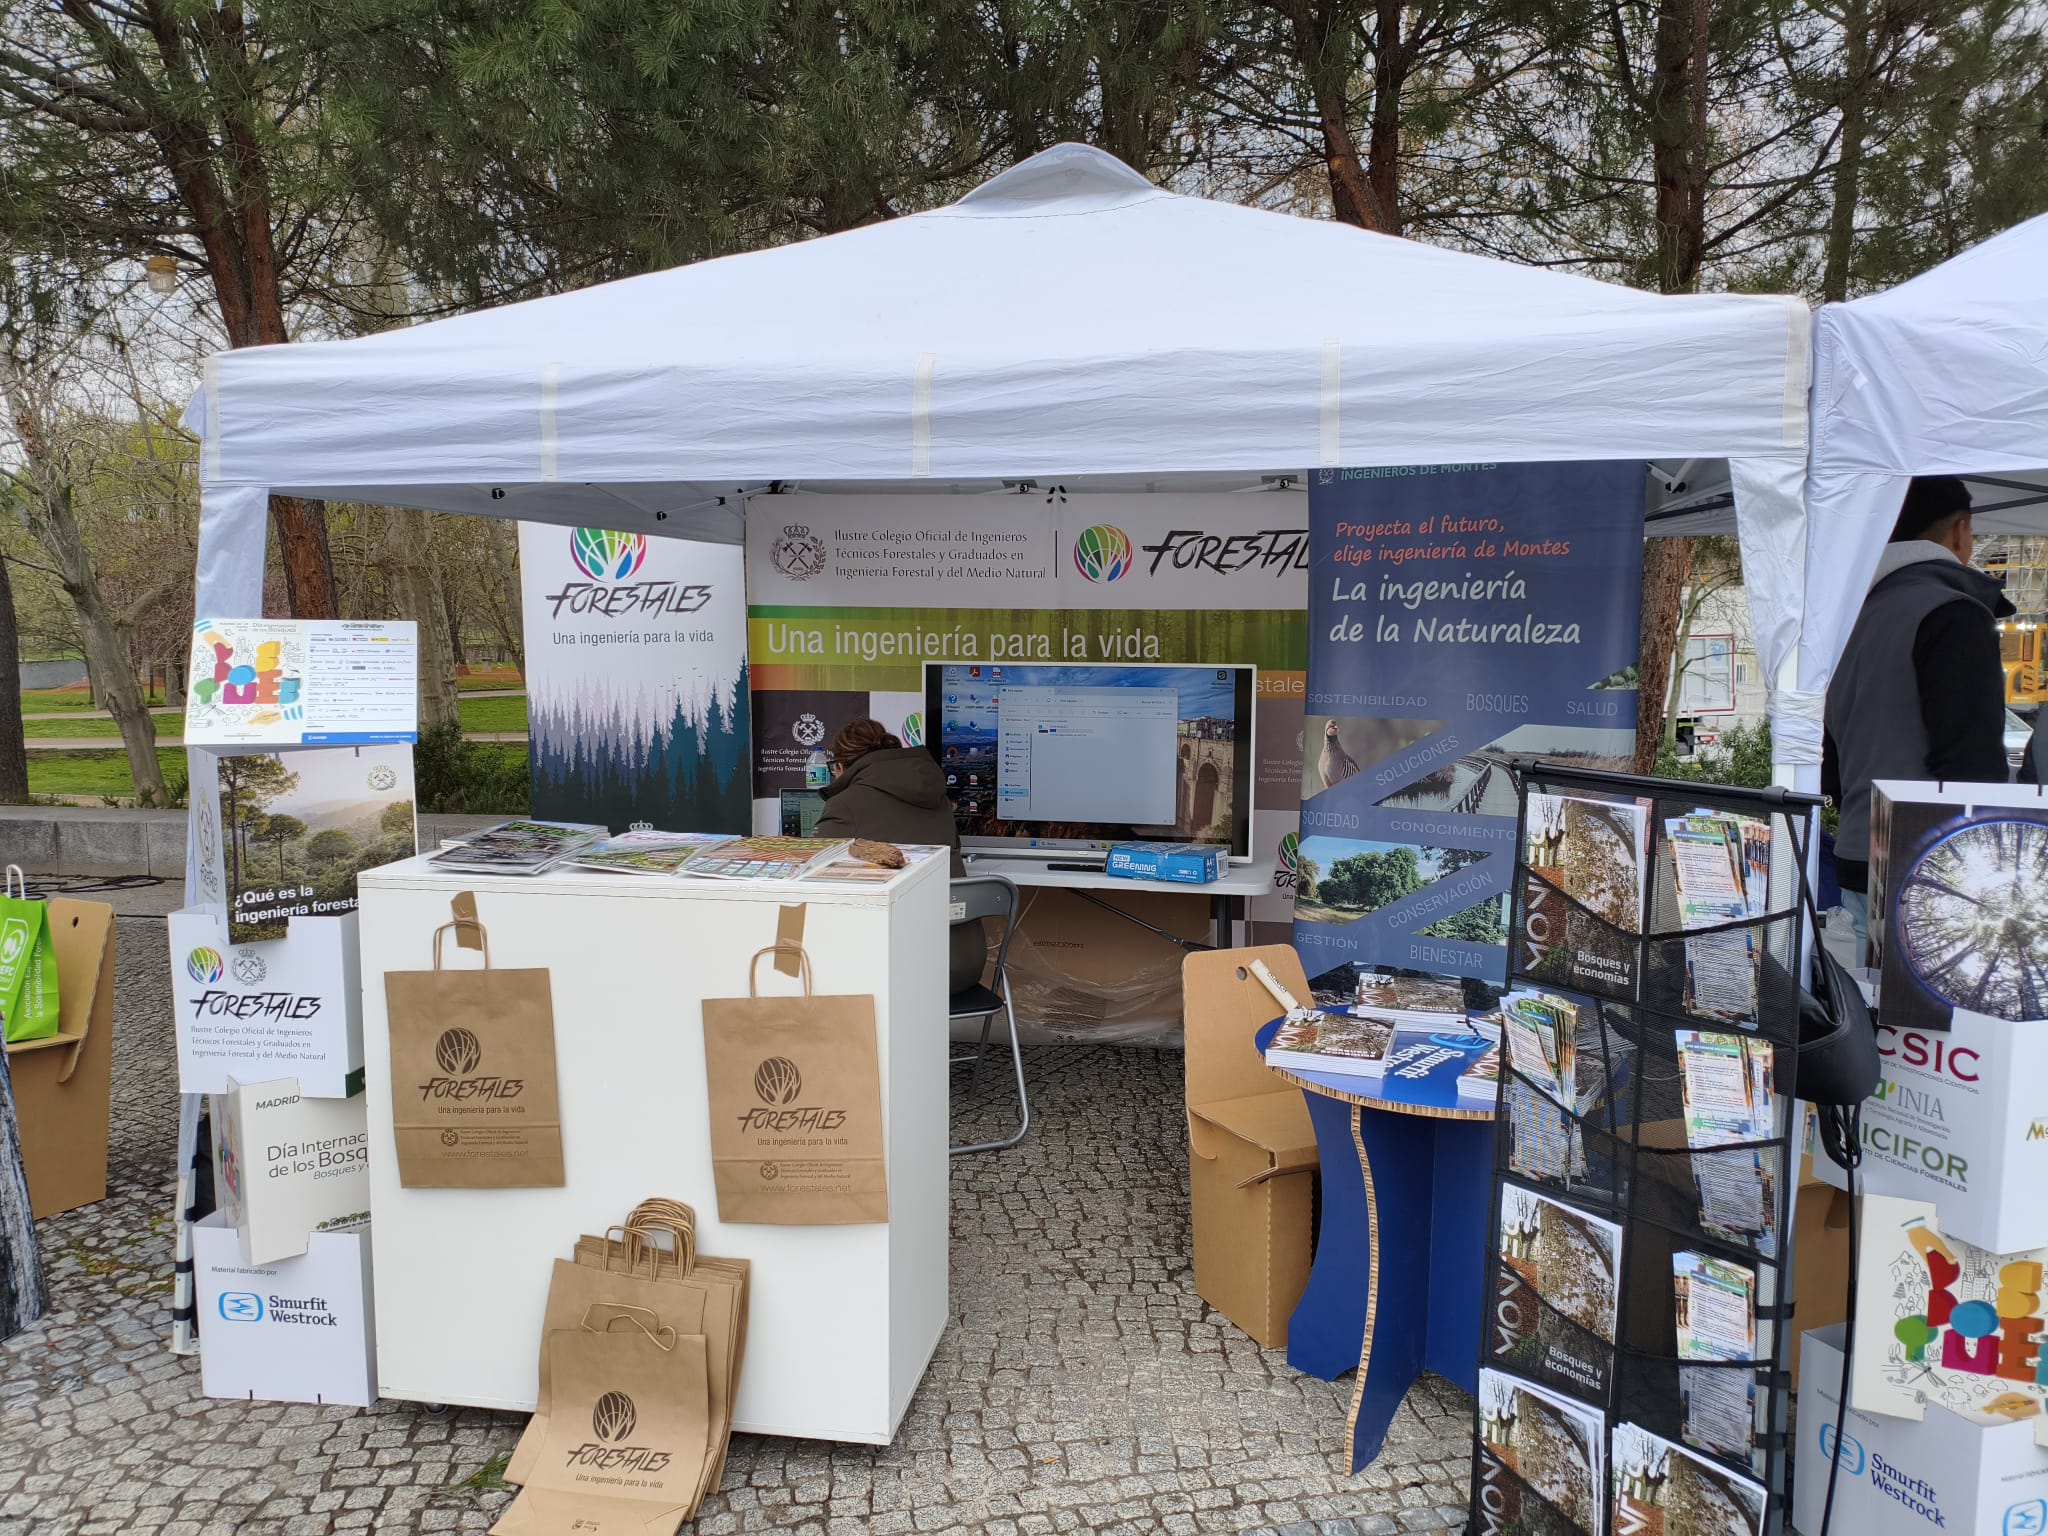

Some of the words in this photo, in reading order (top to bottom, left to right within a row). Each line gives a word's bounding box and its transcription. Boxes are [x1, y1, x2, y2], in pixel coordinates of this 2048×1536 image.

[1341, 465, 1416, 481] INGENIEROS
[1420, 464, 1437, 475] DE
[834, 529, 869, 541] Ilustre
[871, 529, 912, 545] Colegio
[915, 529, 951, 542] Oficial
[954, 530, 968, 542] de
[971, 531, 1028, 545] Ingenieros
[1336, 520, 1411, 542] Proyecta
[1419, 516, 1434, 535] el
[1440, 514, 1505, 534] futuro,
[835, 547, 880, 560] Técnicos
[883, 548, 936, 560] Forestales
[939, 551, 946, 563] y
[948, 549, 1007, 561] Graduados
[1010, 551, 1024, 561] en
[1333, 544, 1371, 567] elige
[1378, 541, 1467, 565] ingeniería
[1474, 540, 1496, 558] de
[1503, 538, 1571, 558] Montes
[892, 566, 934, 578] Forestal
[937, 570, 943, 581] y
[947, 567, 963, 578] del
[966, 567, 1002, 579] Medio
[1005, 567, 1046, 579] Natural
[545, 580, 714, 620] FORESTALES
[1332, 576, 1367, 602] La
[1379, 569, 1527, 610] ingeniería
[552, 631, 577, 645] Una
[579, 629, 640, 647] ingeniería
[643, 631, 671, 646] para
[674, 630, 686, 643] la
[688, 629, 714, 643] vida
[1329, 614, 1364, 642] de
[1376, 614, 1400, 643] la
[1412, 613, 1582, 645] Naturaleza
[768, 623, 824, 656] Una
[836, 622, 978, 662] ingeniería
[989, 628, 1051, 662] para
[1063, 628, 1087, 658] la
[1098, 628, 1161, 659] vida
[1307, 693, 1428, 708] SOSTENIBILIDAD
[1466, 694, 1529, 713] BOSQUES
[1566, 700, 1619, 716] SALUD
[1375, 735, 1461, 787] SOLUCIONES
[1302, 810, 1360, 829] SOCIEDAD
[1390, 820, 1517, 841] CONOCIMIENTO
[1112, 861, 1157, 872] GREENING
[235, 888, 275, 908] ¿Qué
[279, 888, 296, 900] es
[300, 885, 314, 896] la
[1387, 871, 1494, 929] CONSERVACIÓN
[235, 902, 309, 924] ingeniería
[1296, 932, 1358, 950] GESTIÓN
[1410, 944, 1483, 969] BIENESTAR
[1577, 950, 1621, 971] Bosques
[1623, 962, 1630, 974] y
[1573, 964, 1630, 985] economías
[189, 990, 322, 1022] FORESTALES
[214, 1025, 240, 1036] Colegio
[241, 1026, 265, 1035] Oficial
[266, 1027, 275, 1035] de
[277, 1028, 313, 1038] Ingenieros
[222, 1038, 256, 1046] Forestales
[263, 1039, 301, 1048] Graduados
[228, 1049, 255, 1057] Forestal
[262, 1050, 273, 1058] del
[275, 1051, 298, 1059] Medio
[300, 1051, 326, 1061] Natural
[1394, 1048, 1465, 1079] Smurfit
[1877, 1024, 1981, 1082] CSIC
[418, 1077, 524, 1102] FORESTALES
[255, 1094, 300, 1110] MADRID
[437, 1105, 451, 1114] Una
[452, 1105, 485, 1115] ingeniería
[487, 1106, 501, 1115] para
[503, 1105, 510, 1113] la
[511, 1105, 525, 1114] vida
[1897, 1084, 1945, 1122] INIA
[736, 1107, 848, 1133] FORESTALES
[2026, 1121, 2048, 1141] M
[267, 1142, 298, 1162] Día
[757, 1137, 771, 1146] Una
[772, 1137, 806, 1148] ingeniería
[807, 1138, 823, 1147] para
[825, 1137, 832, 1145] la
[833, 1137, 848, 1145] vida
[1862, 1121, 1969, 1184] ICIFOR
[268, 1164, 289, 1178] de
[293, 1160, 315, 1174] los
[314, 1163, 356, 1180] Bosques
[357, 1162, 366, 1173] y
[211, 1265, 236, 1274] Material
[236, 1266, 265, 1276] fabricado
[269, 1295, 328, 1311] Smurfit
[269, 1309, 338, 1327] Westrock
[1549, 1345, 1594, 1375] Bosques
[1595, 1368, 1603, 1380] y
[1545, 1358, 1601, 1391] economías
[566, 1443, 674, 1475] FORESTALES
[575, 1473, 589, 1482] Una
[590, 1474, 624, 1486] ingeniería
[623, 1478, 640, 1488] para
[640, 1479, 648, 1487] la
[649, 1480, 663, 1488] vida
[1871, 1452, 1937, 1505] Smurfit
[1870, 1468, 1947, 1529] Westrock
